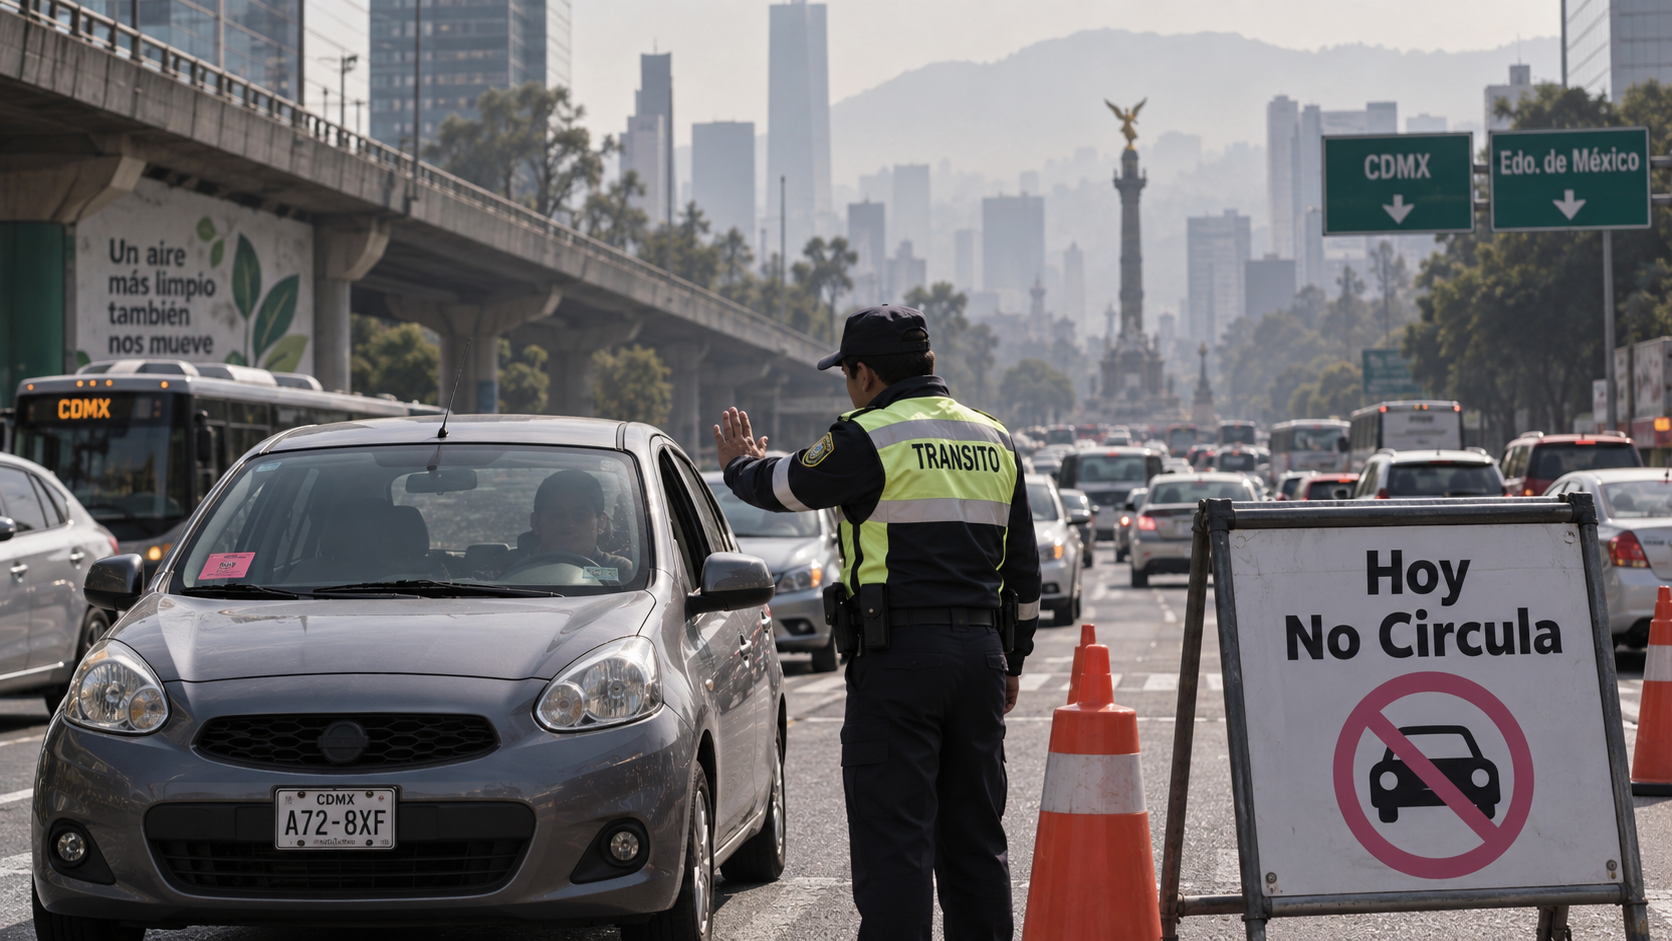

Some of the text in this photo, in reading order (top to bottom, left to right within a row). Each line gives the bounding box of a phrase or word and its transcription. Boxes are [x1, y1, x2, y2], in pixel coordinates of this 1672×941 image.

[1364, 153, 1431, 180] CDMX
[1500, 147, 1640, 175] Edo. de México
[109, 238, 186, 267] Un aire
[109, 269, 216, 302] más limpio
[108, 301, 190, 326] también
[109, 335, 213, 355] nos mueve
[57, 398, 111, 420] CDMX
[911, 443, 1000, 473] TRANSITO
[1366, 549, 1471, 606] Hoy
[1285, 607, 1563, 661] No Circula
[316, 793, 355, 805] CDMX
[284, 809, 386, 836] A72-8XF
